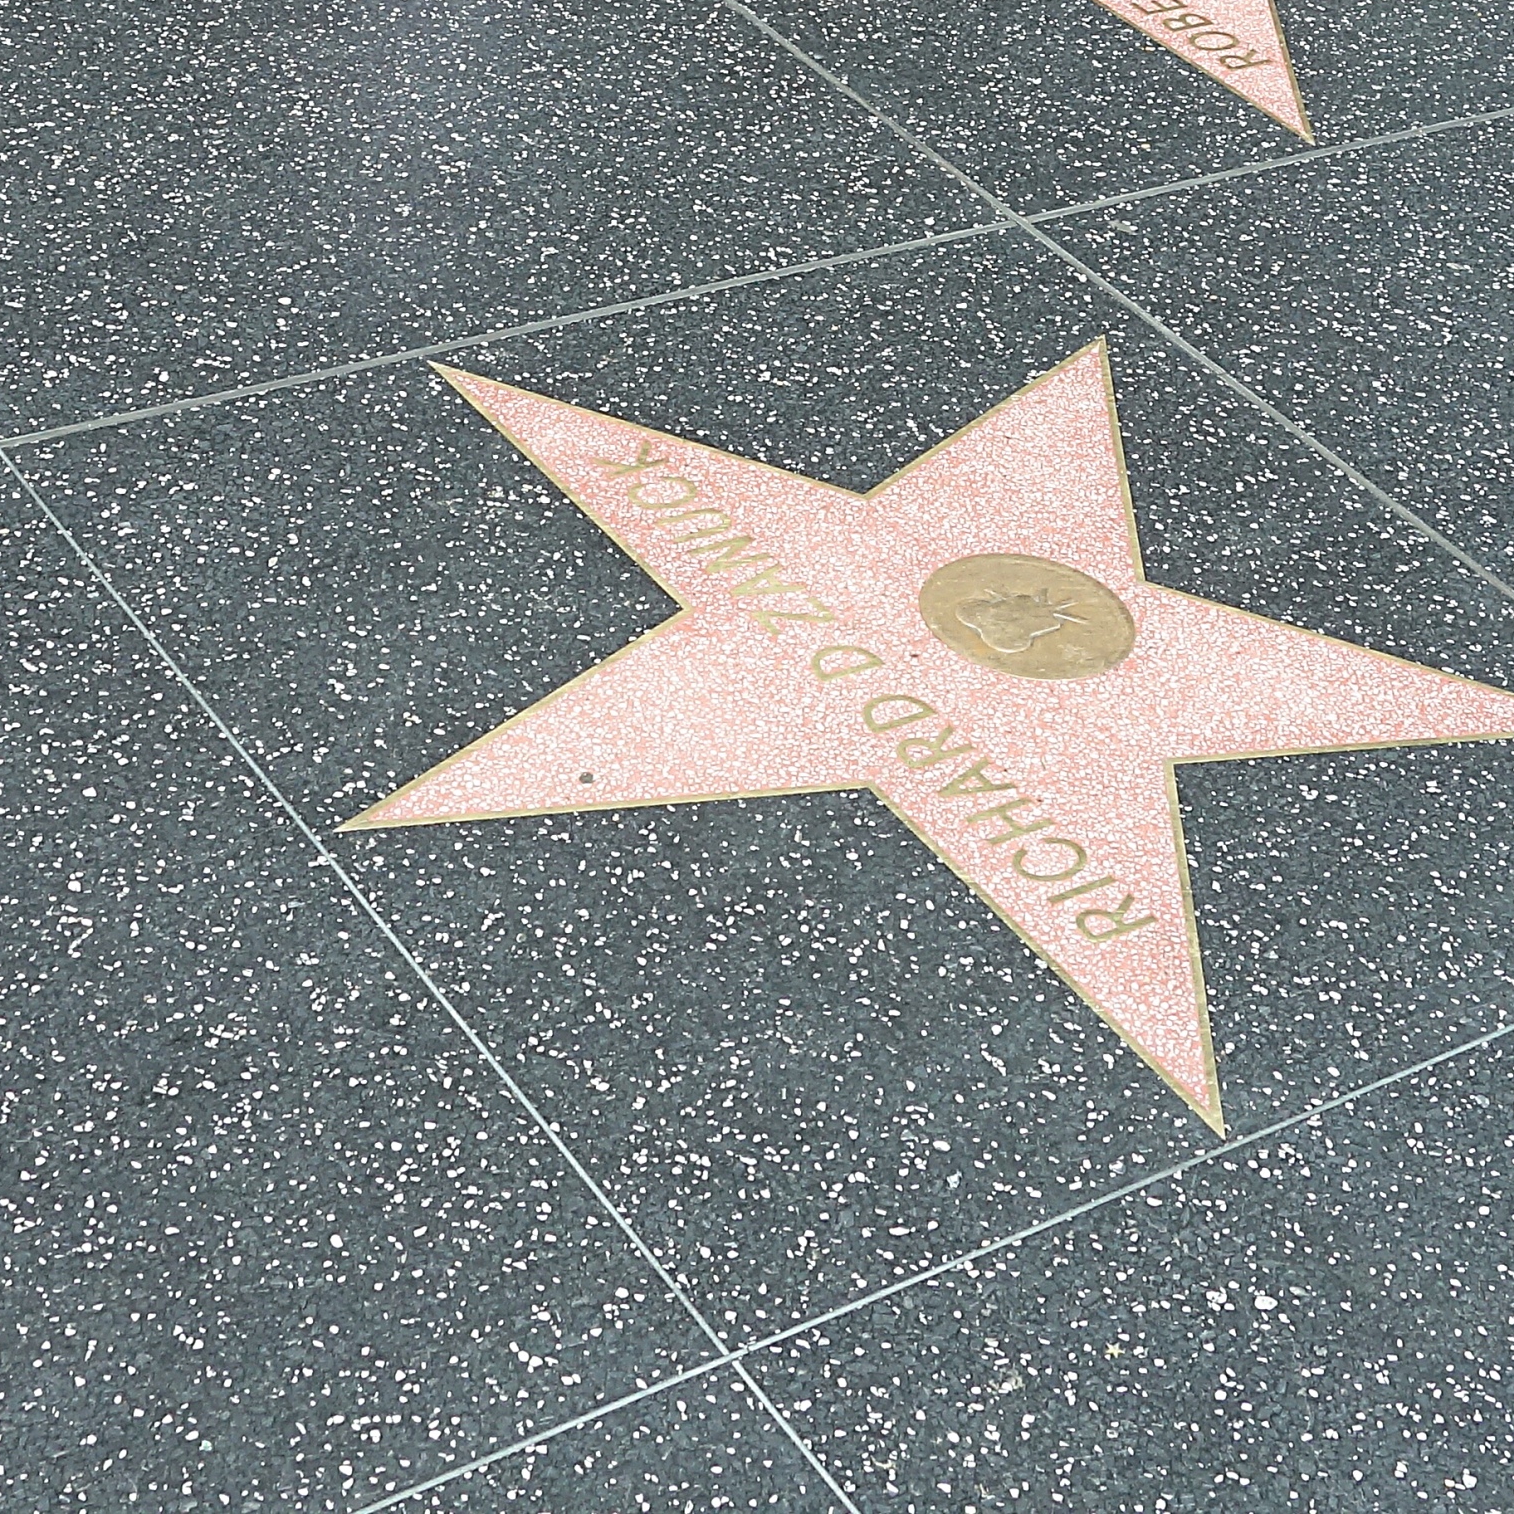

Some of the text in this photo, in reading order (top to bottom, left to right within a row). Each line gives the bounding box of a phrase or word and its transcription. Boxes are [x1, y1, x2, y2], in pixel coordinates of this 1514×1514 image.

[596, 440, 1159, 944] RICHARD D ZANUCK
